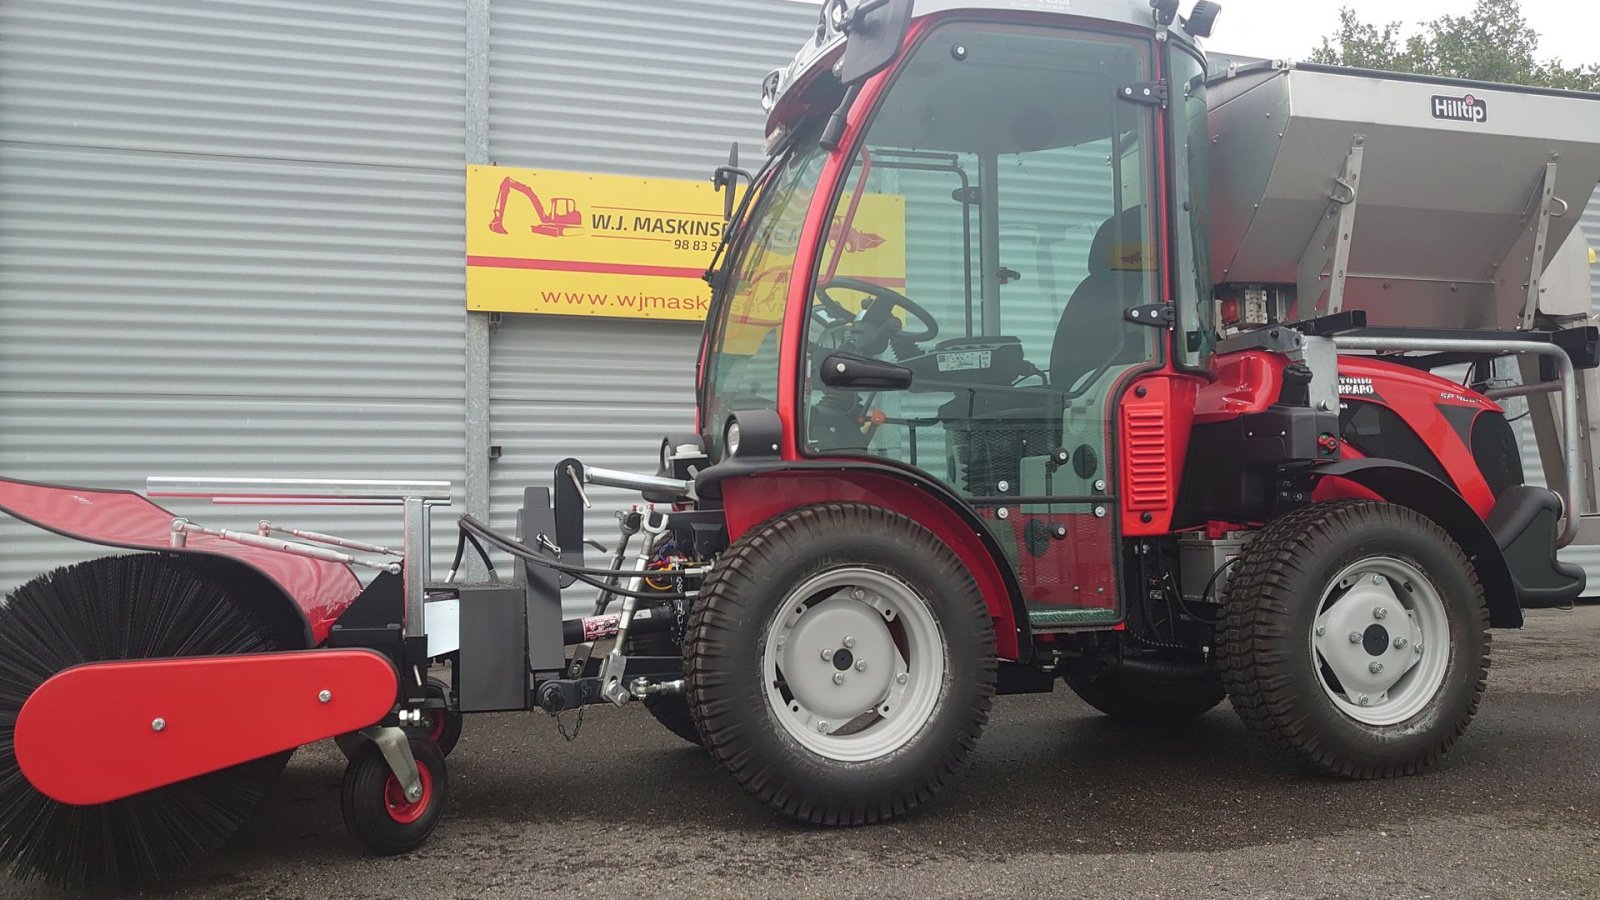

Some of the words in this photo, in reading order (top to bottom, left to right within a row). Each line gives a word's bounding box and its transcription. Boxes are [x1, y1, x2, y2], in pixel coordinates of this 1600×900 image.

[1434, 98, 1484, 123] Hilltip
[591, 213, 628, 231] W.J.
[673, 239, 690, 250] 98
[692, 240, 708, 251] 83
[540, 291, 708, 312] www.wjmask
[1338, 384, 1375, 395] RRARO
